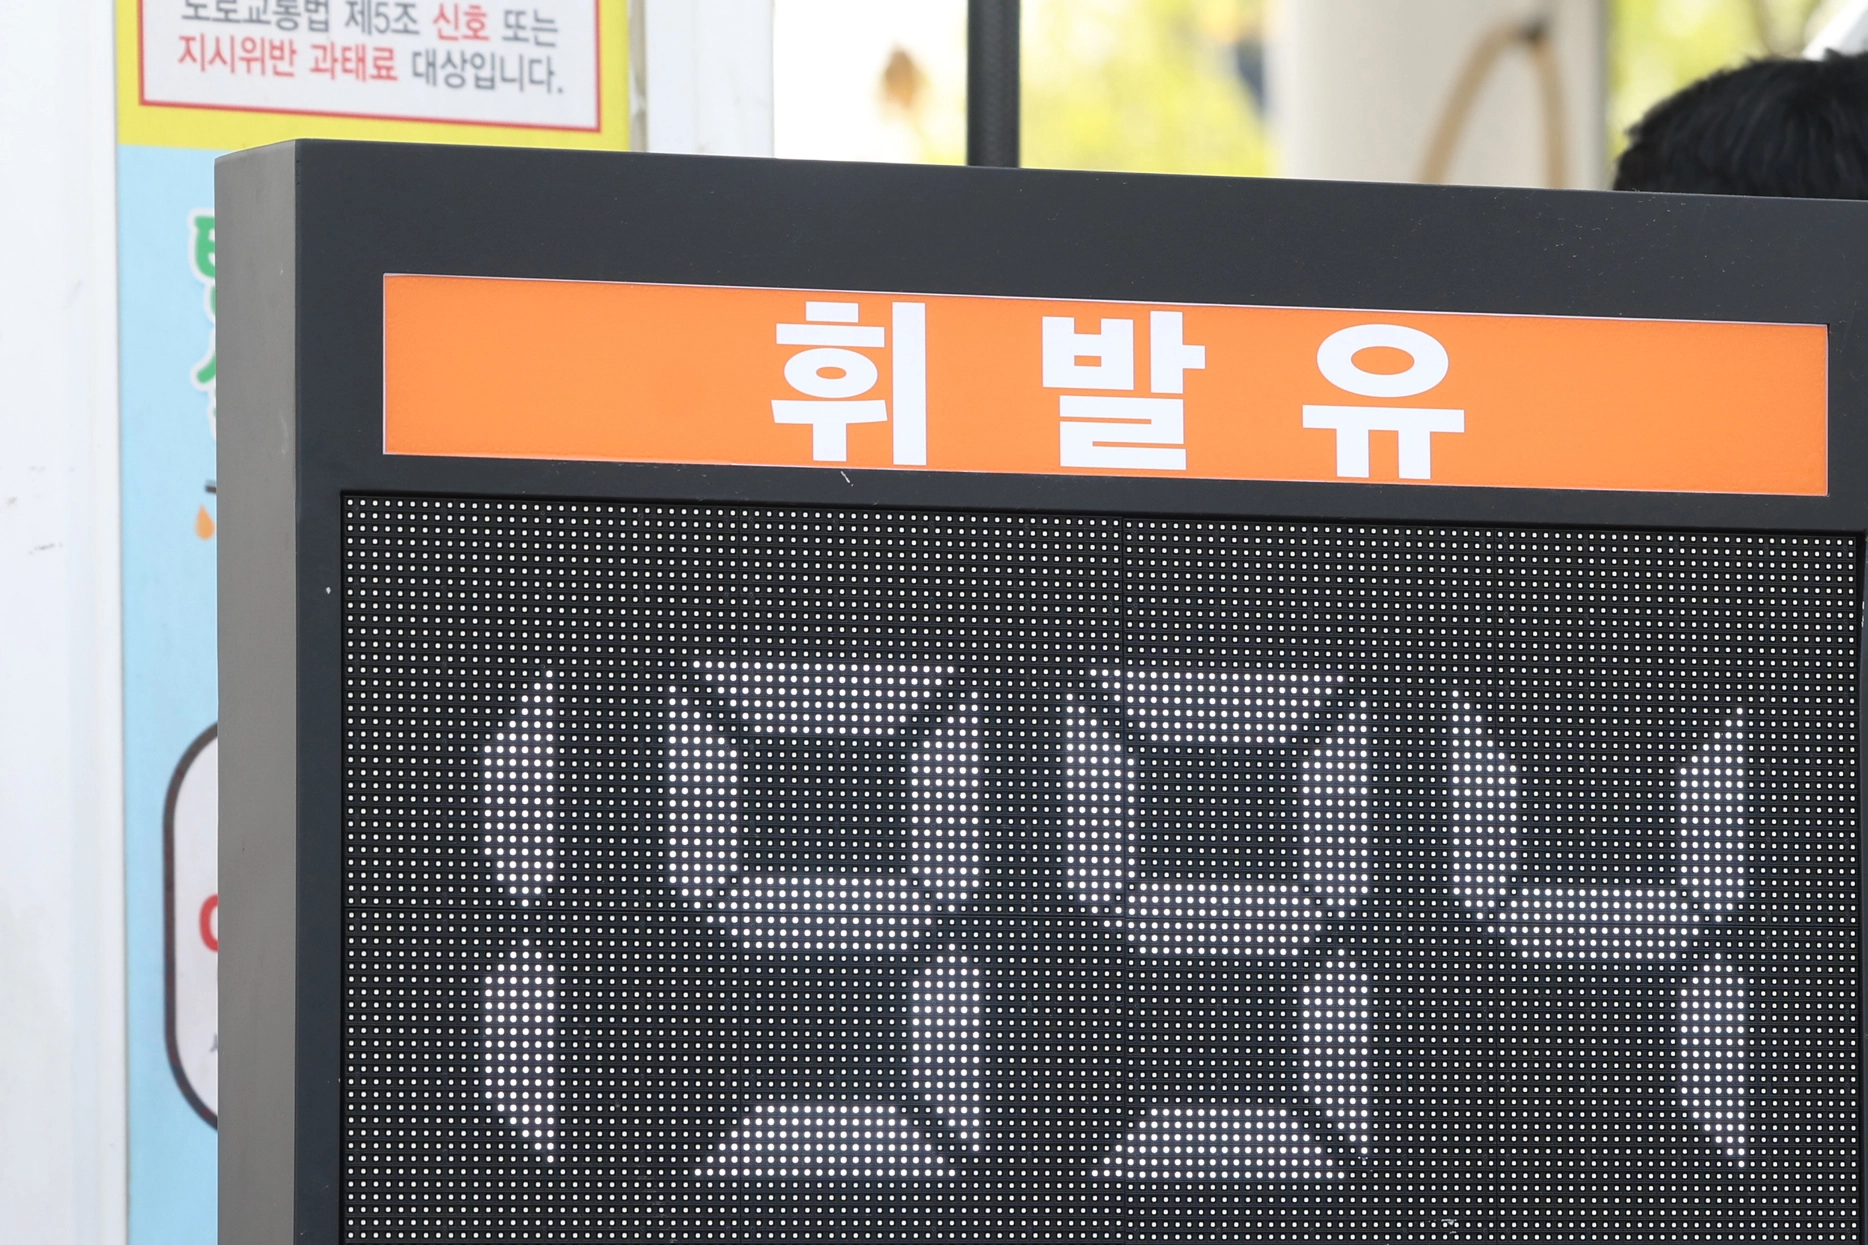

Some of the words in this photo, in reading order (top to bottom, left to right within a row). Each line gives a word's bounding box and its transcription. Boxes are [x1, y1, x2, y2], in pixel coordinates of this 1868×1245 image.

[177, 32, 298, 78] 지시위반
[309, 40, 398, 83] 과태료
[411, 47, 564, 95] 대상입니다.
[344, 0, 421, 36] 제5조
[432, 2, 491, 42] 신호
[501, 7, 559, 48] 또는
[771, 301, 1465, 481] 휘발유
[480, 659, 1748, 1181] 1994
